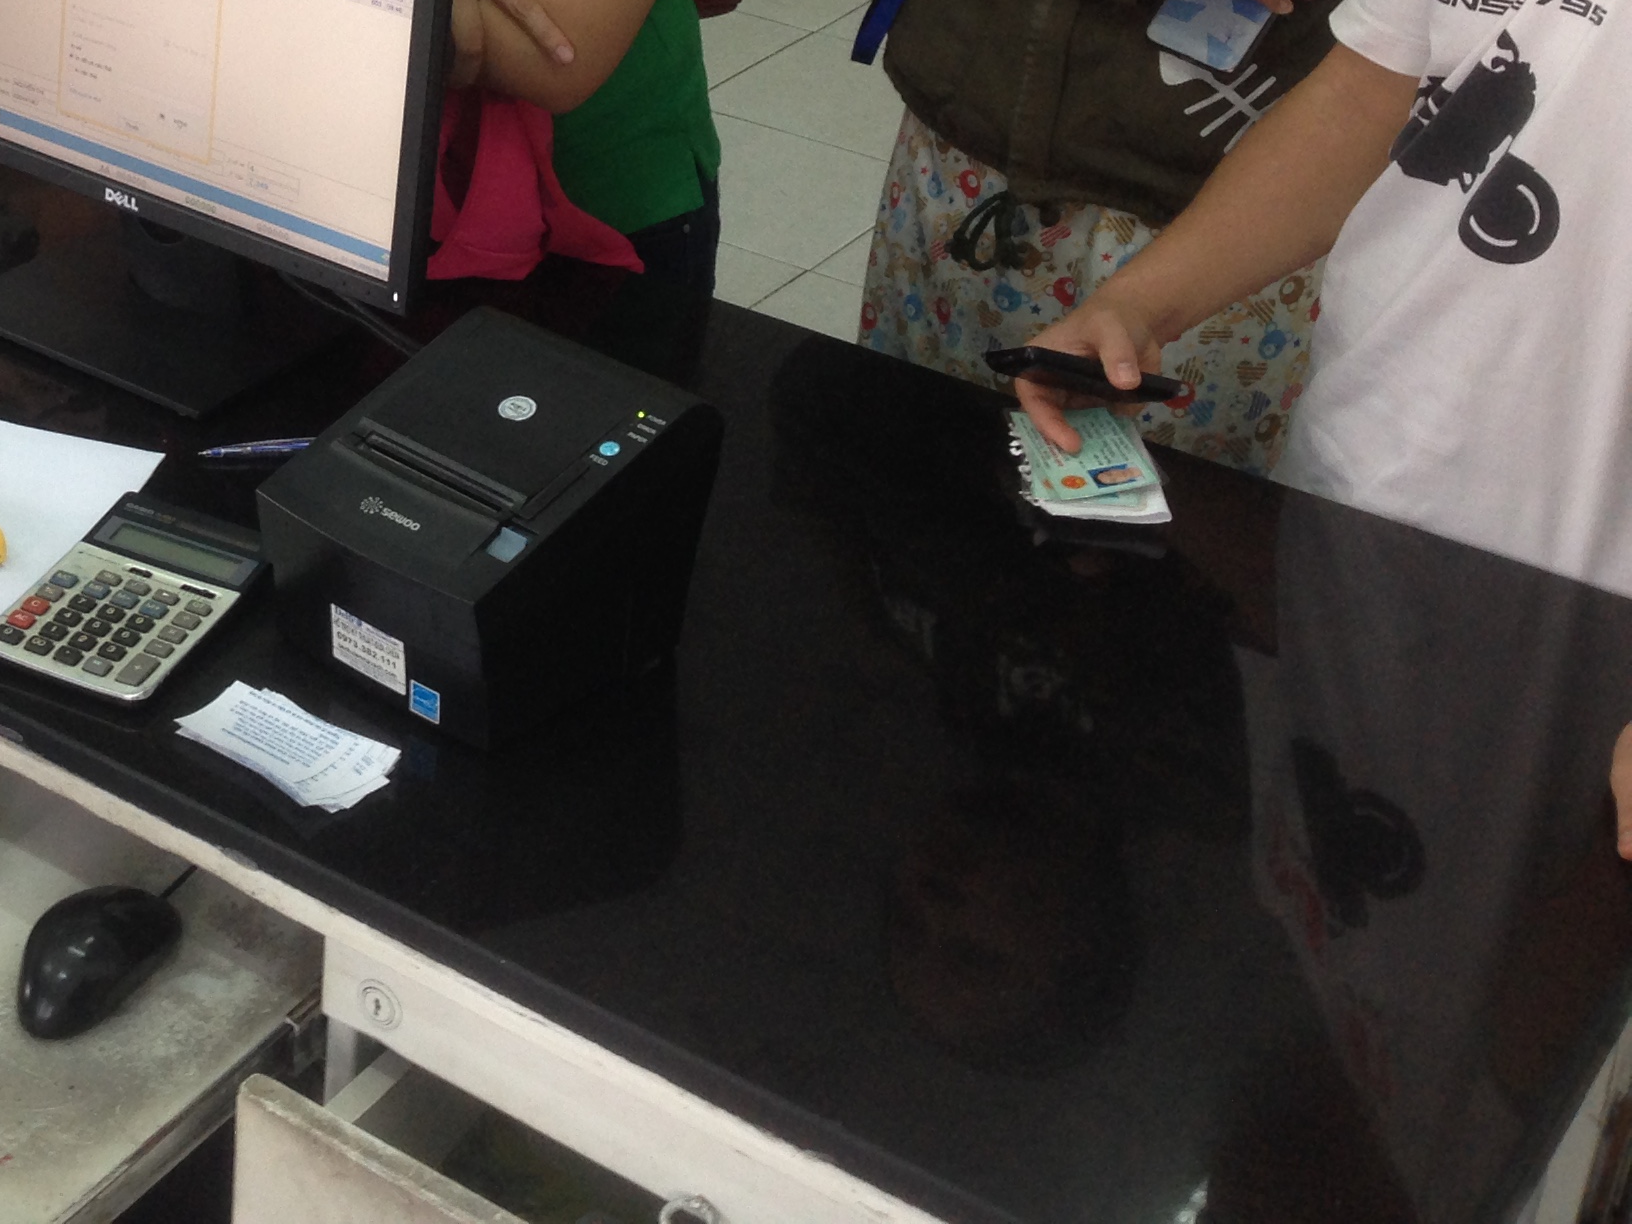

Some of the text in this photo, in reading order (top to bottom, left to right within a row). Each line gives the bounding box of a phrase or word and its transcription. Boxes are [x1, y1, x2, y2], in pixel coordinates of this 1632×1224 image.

[104, 186, 139, 212] DELL
[589, 453, 609, 467] FEED
[380, 507, 421, 531] sewoo
